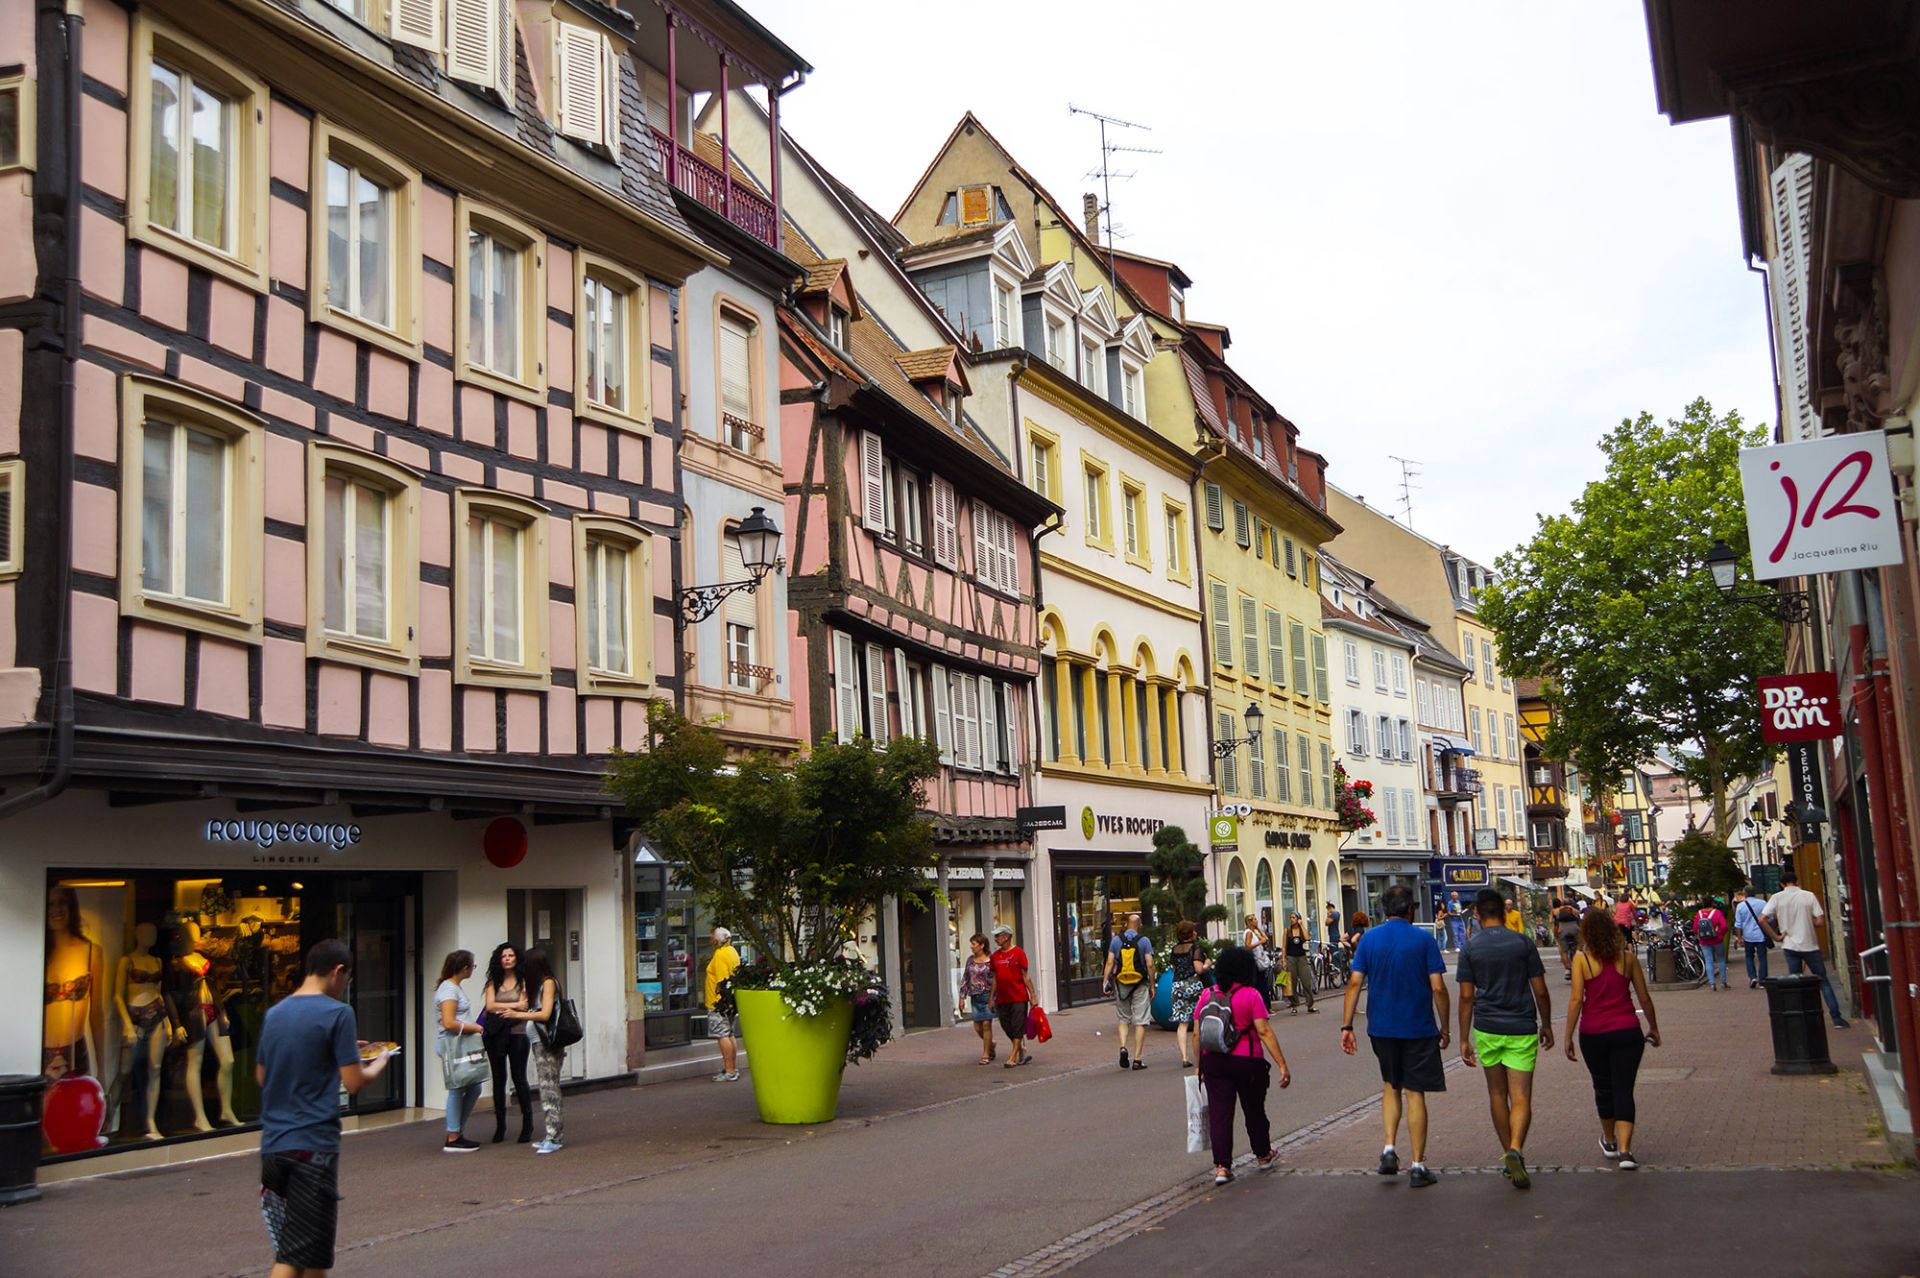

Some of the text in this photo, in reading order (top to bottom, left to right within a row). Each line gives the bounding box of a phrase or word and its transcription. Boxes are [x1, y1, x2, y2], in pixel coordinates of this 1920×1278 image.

[1791, 543, 1879, 560] Jacqueline Riu
[1773, 706, 1831, 731] am
[1800, 748, 1815, 811] SEPHORA
[1096, 814, 1124, 835] YVES
[253, 856, 320, 864] LINGERIE
